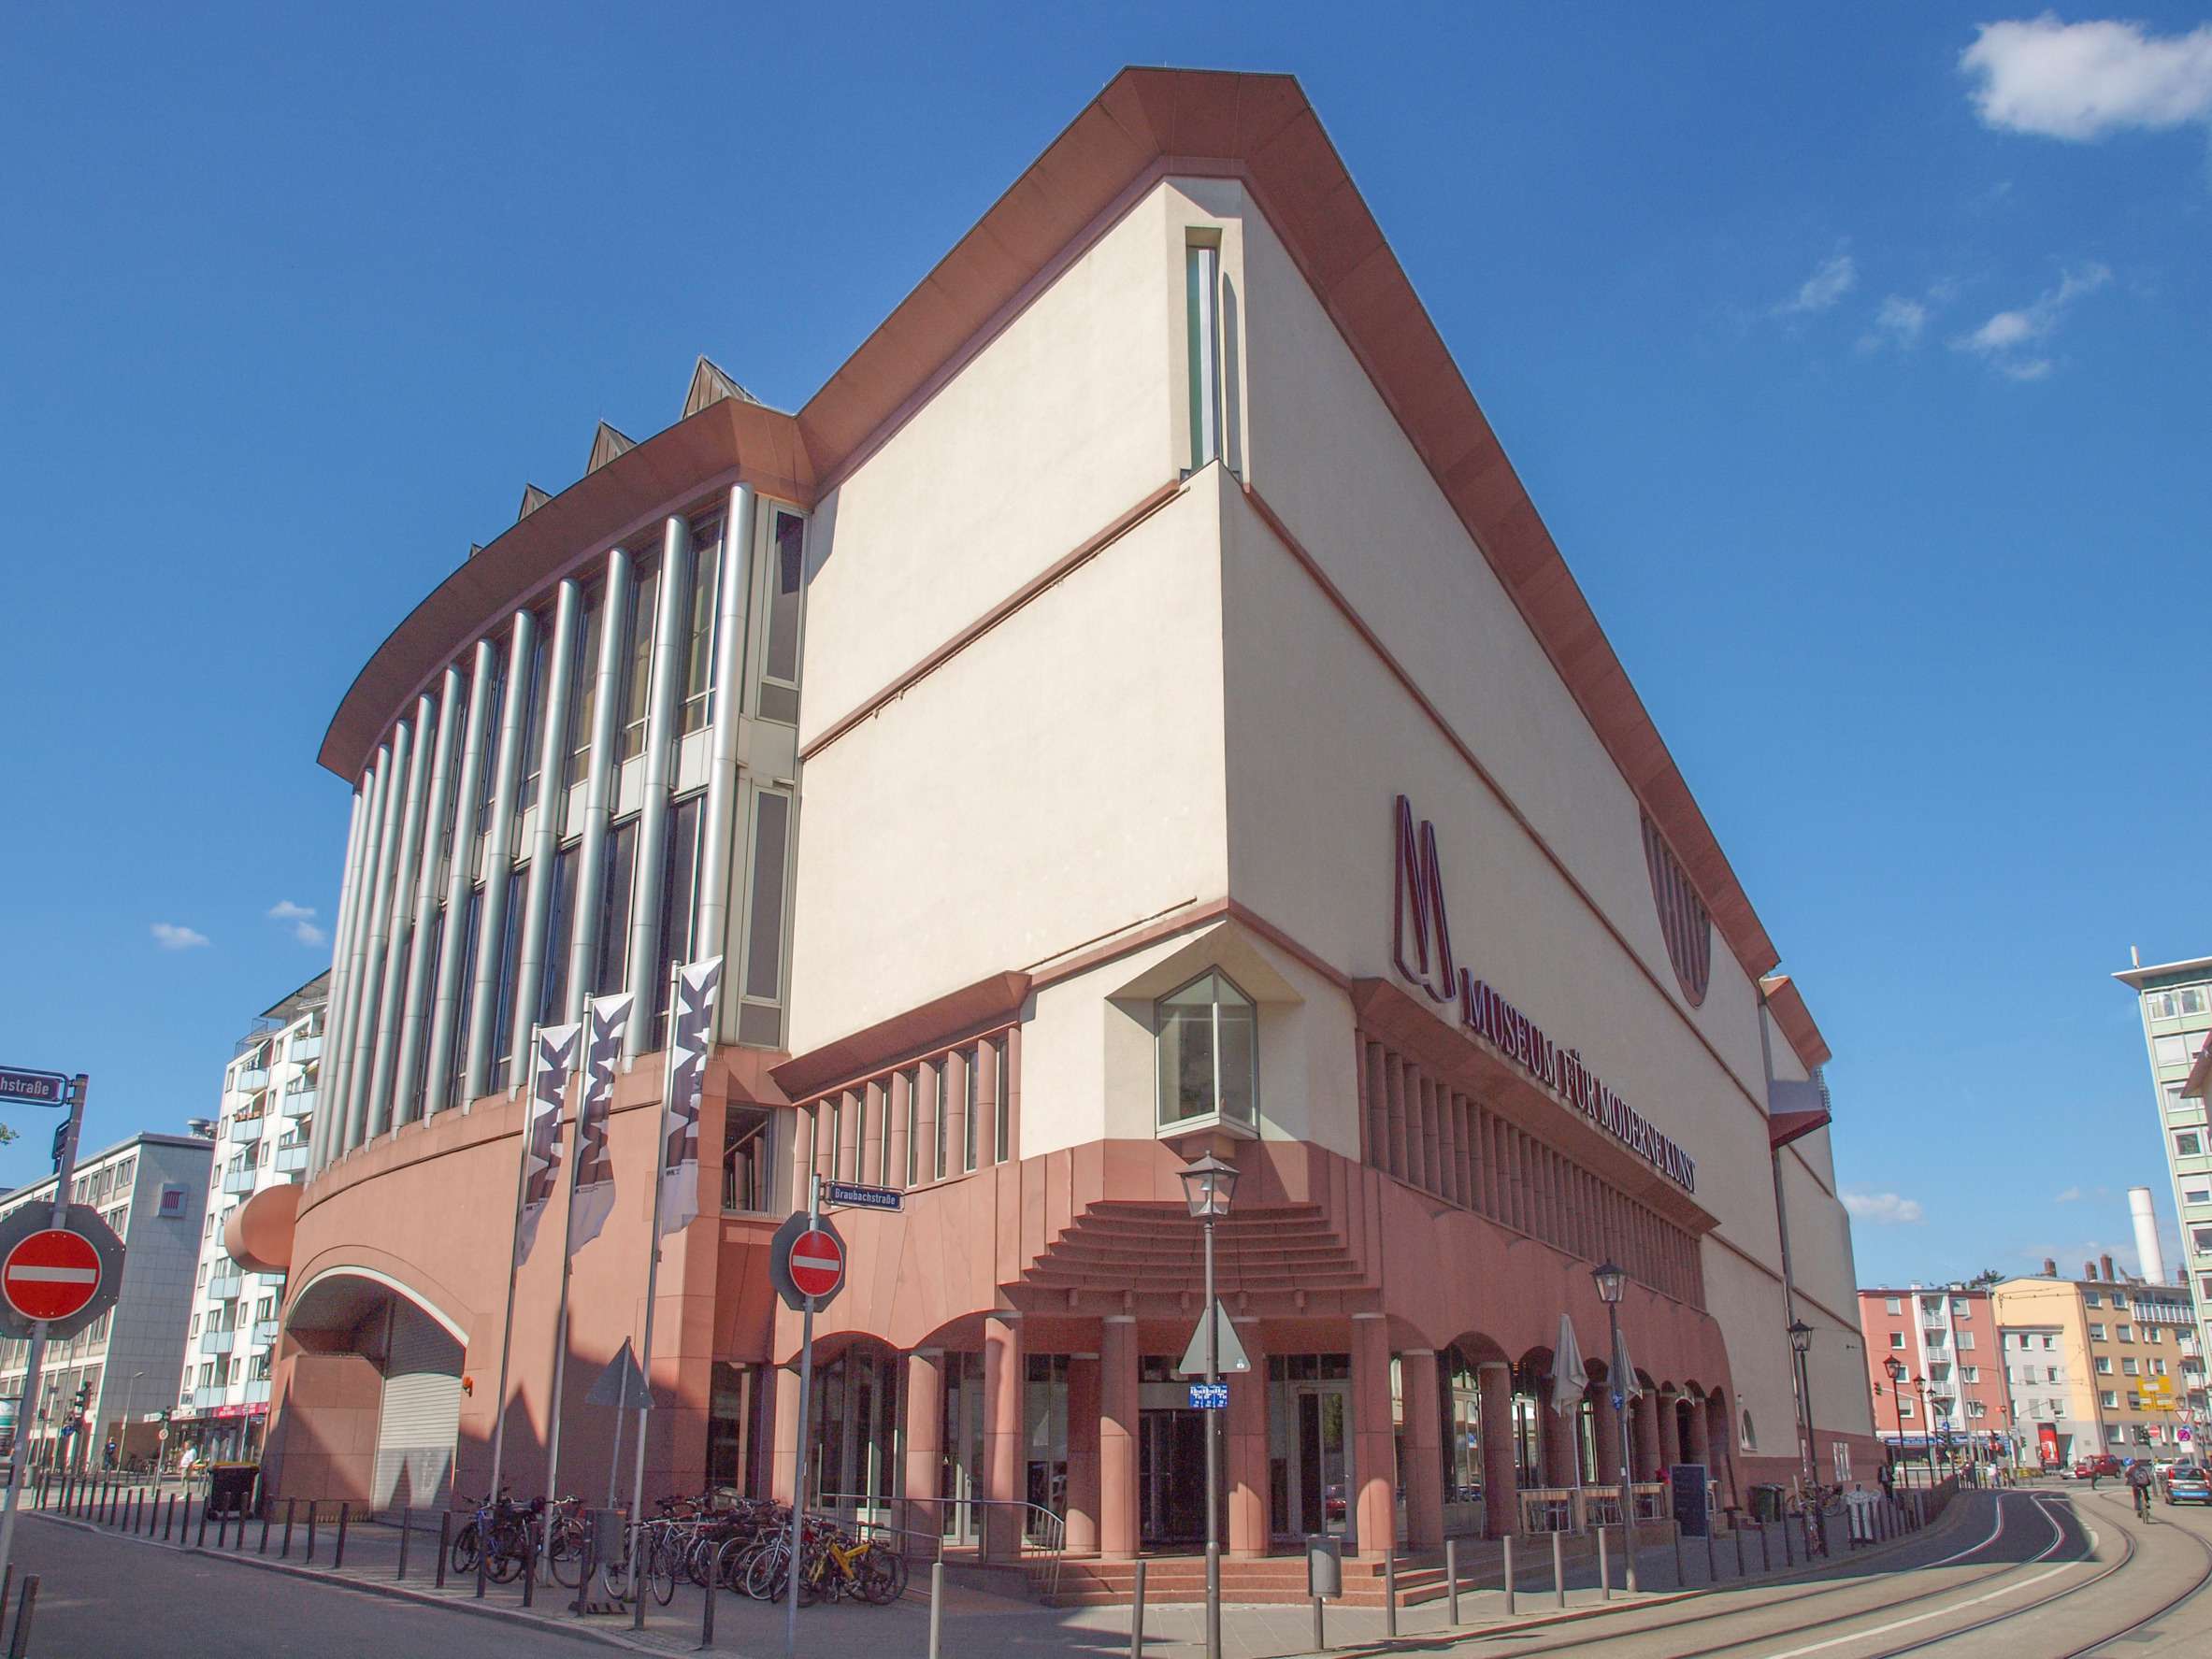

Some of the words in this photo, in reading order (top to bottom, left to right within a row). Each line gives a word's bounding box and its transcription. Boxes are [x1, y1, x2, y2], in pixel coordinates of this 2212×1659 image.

[0, 1076, 50, 1095] hstraße
[1459, 966, 1558, 1092] MUSEUM
[1558, 1048, 1598, 1120] FÜR
[1594, 1078, 1664, 1170] MODERNE
[1663, 1136, 1697, 1194] KUNST
[835, 1188, 896, 1205] Braubachstraße
